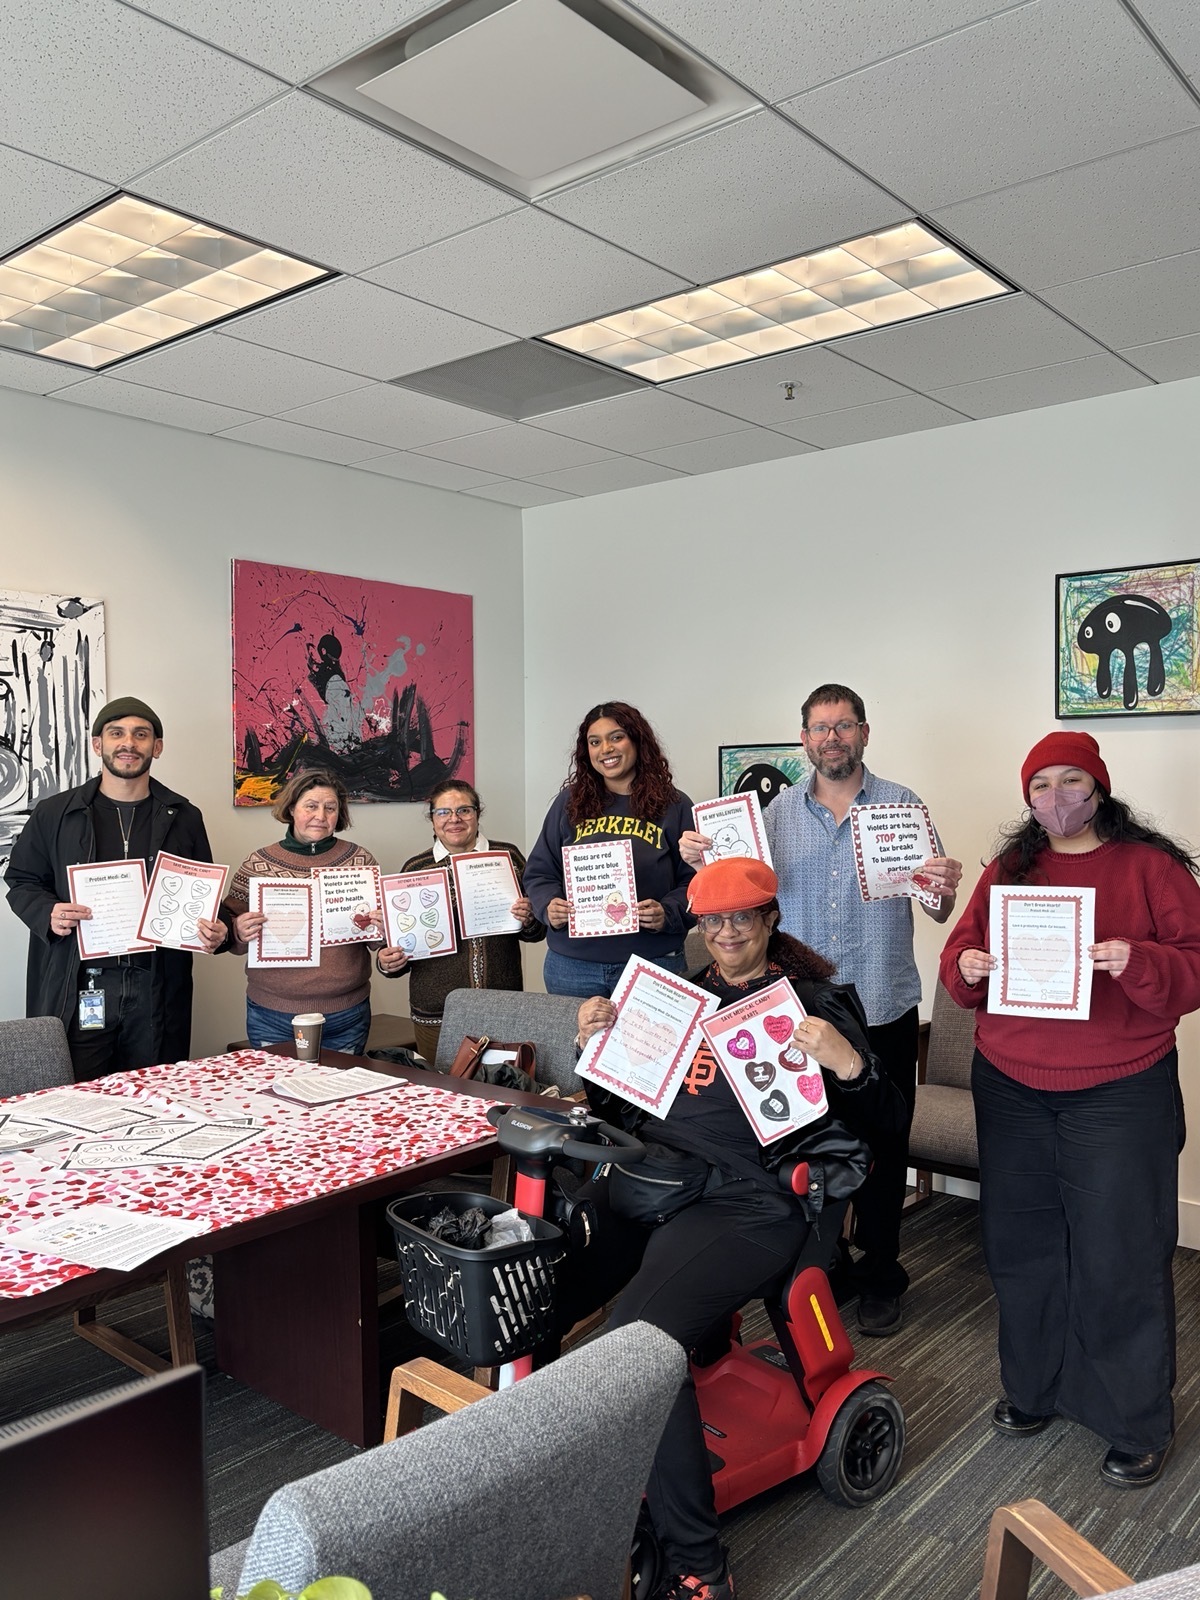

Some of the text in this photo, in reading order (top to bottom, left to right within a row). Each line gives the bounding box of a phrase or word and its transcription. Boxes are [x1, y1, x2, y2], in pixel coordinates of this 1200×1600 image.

[902, 822, 920, 830] hardy
[875, 833, 918, 844] STOP giving
[887, 865, 910, 873] parties
[576, 884, 596, 893] FUND
[720, 1014, 733, 1022] SAVE
[755, 995, 771, 1006] CANDY
[741, 1010, 759, 1021] HEARTS
